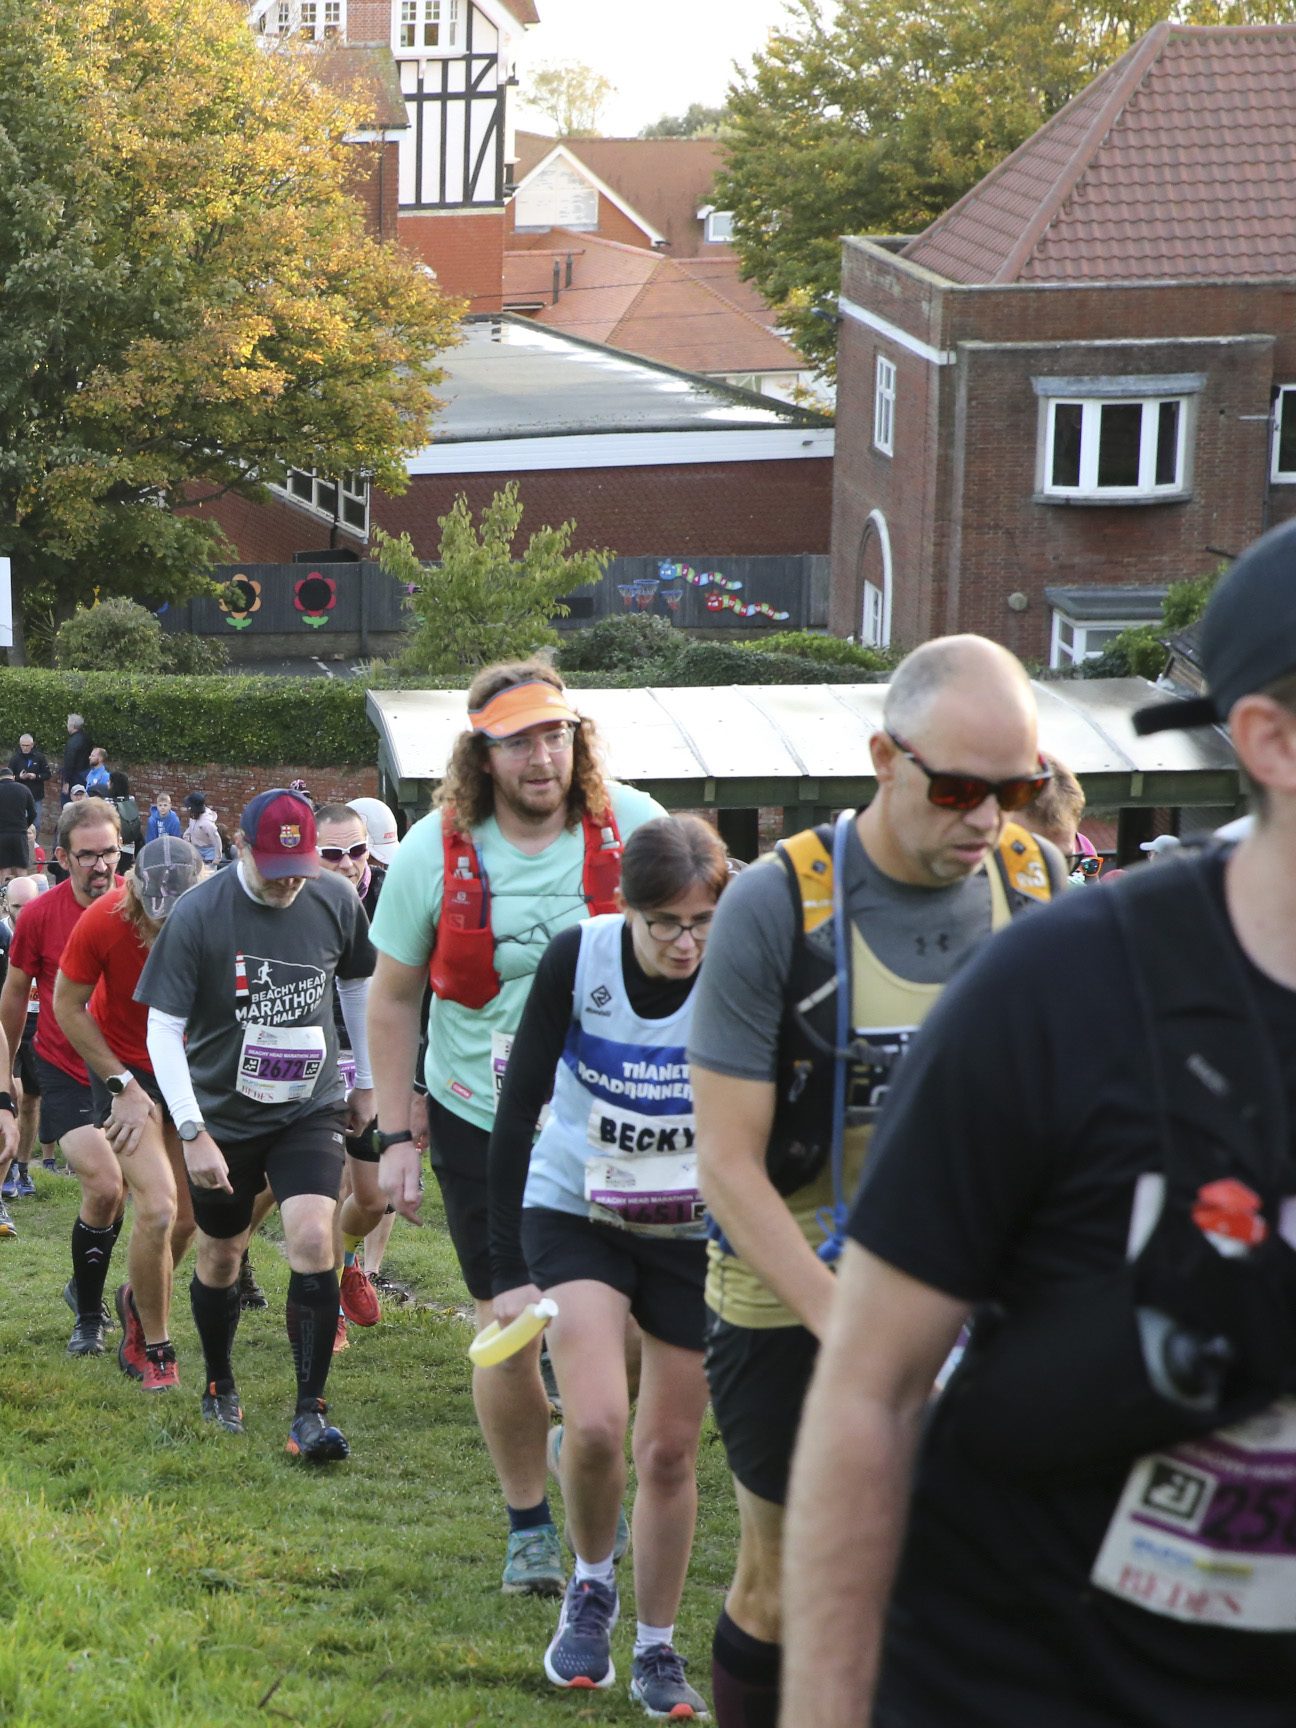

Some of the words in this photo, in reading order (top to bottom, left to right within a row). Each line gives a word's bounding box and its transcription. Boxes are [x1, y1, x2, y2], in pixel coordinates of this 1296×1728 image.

[251, 983, 296, 1003] BEACHY
[298, 972, 326, 991] HEAD
[235, 983, 325, 1022] MARATHON
[273, 1008, 302, 1025] HALF
[259, 1058, 304, 1078] 2672
[622, 1061, 691, 1081] THANET
[600, 1116, 695, 1153] BECKY
